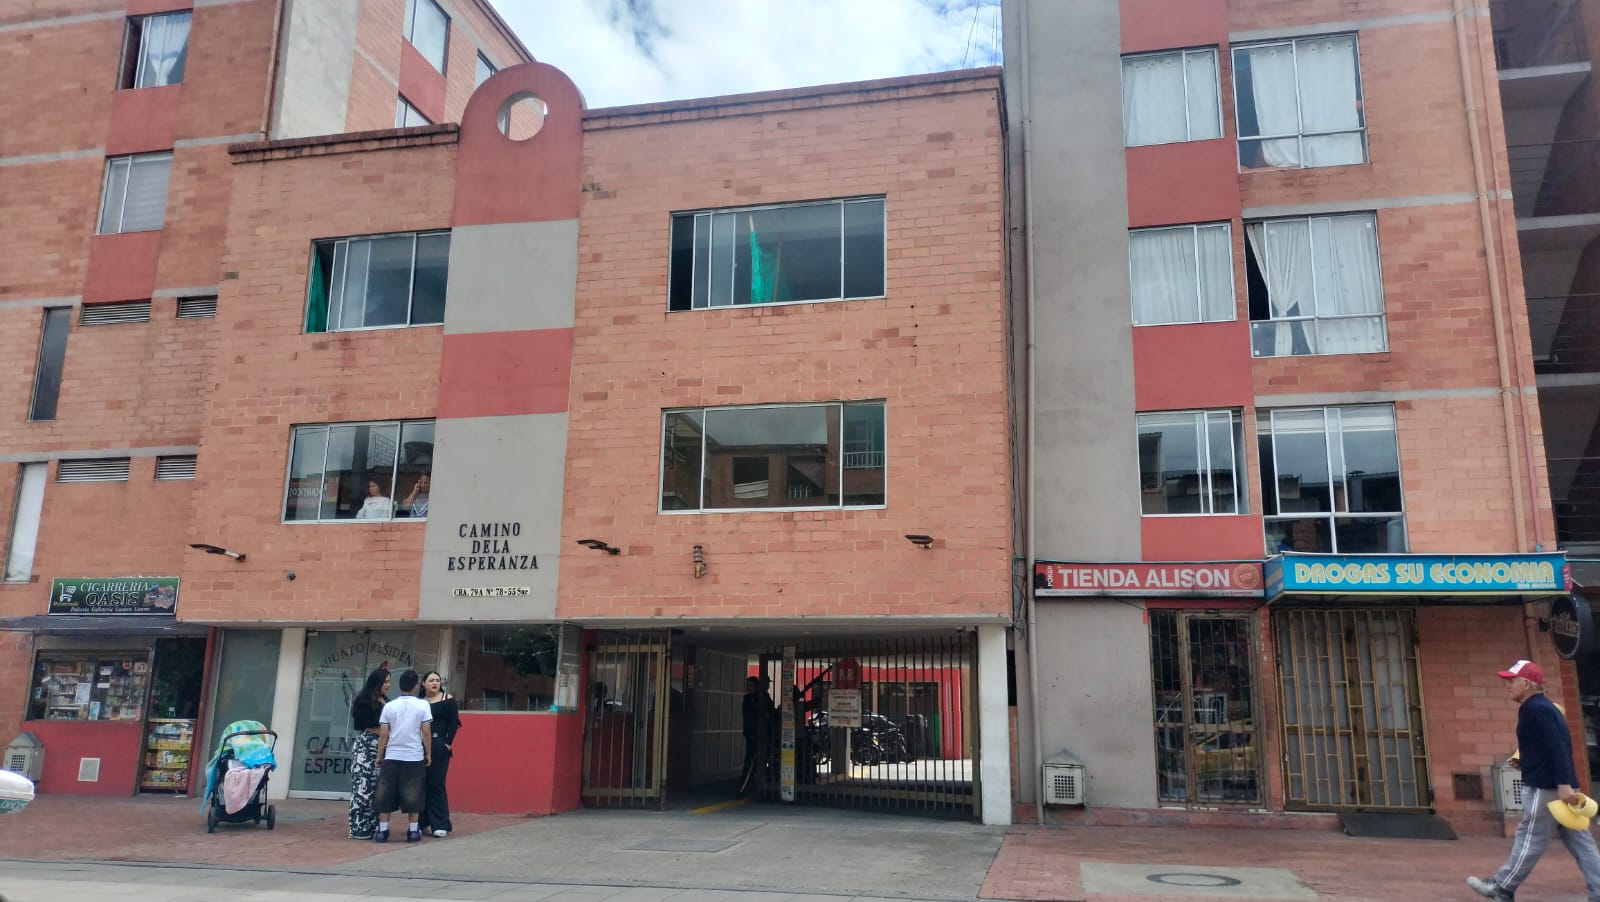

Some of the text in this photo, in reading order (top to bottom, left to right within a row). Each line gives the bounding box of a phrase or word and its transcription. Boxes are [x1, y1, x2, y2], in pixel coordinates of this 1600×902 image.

[459, 522, 521, 538] CAMINO
[447, 555, 539, 571] ESPERANZA
[1058, 569, 1140, 588] TIENDA
[1144, 568, 1230, 588] ALISON
[1294, 562, 1390, 584] DROGAS
[1395, 563, 1424, 584] SU
[1430, 561, 1555, 584] ECONOMIA
[80, 581, 149, 592] CIGARRERIA
[85, 591, 140, 606] OASIS
[304, 758, 352, 774] ESPER
